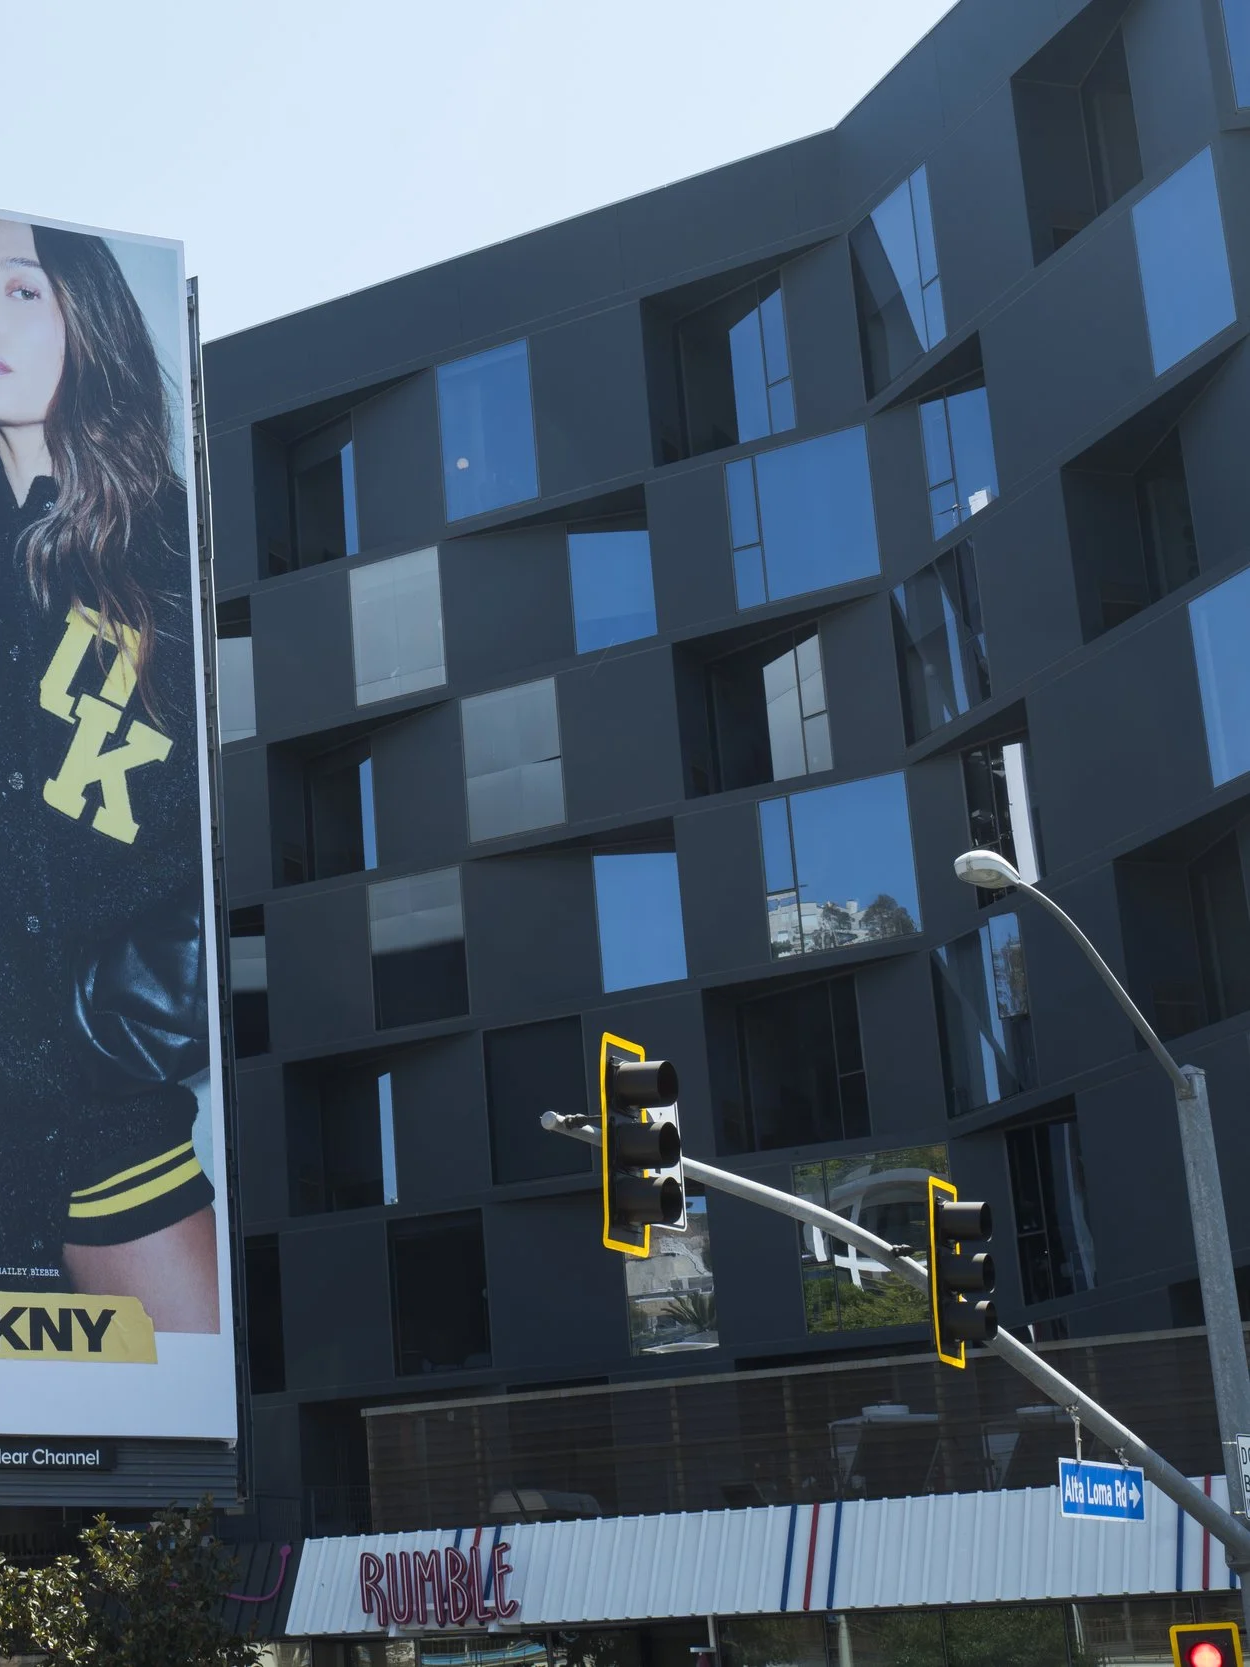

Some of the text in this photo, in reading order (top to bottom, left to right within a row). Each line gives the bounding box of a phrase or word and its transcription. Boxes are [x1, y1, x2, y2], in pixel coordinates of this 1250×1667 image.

[30, 1267, 60, 1277] BIEBER
[32, 1449, 100, 1465] Channel
[1064, 1474, 1128, 1508] Alta Loma Rd
[360, 1541, 519, 1628] RUMBLE
